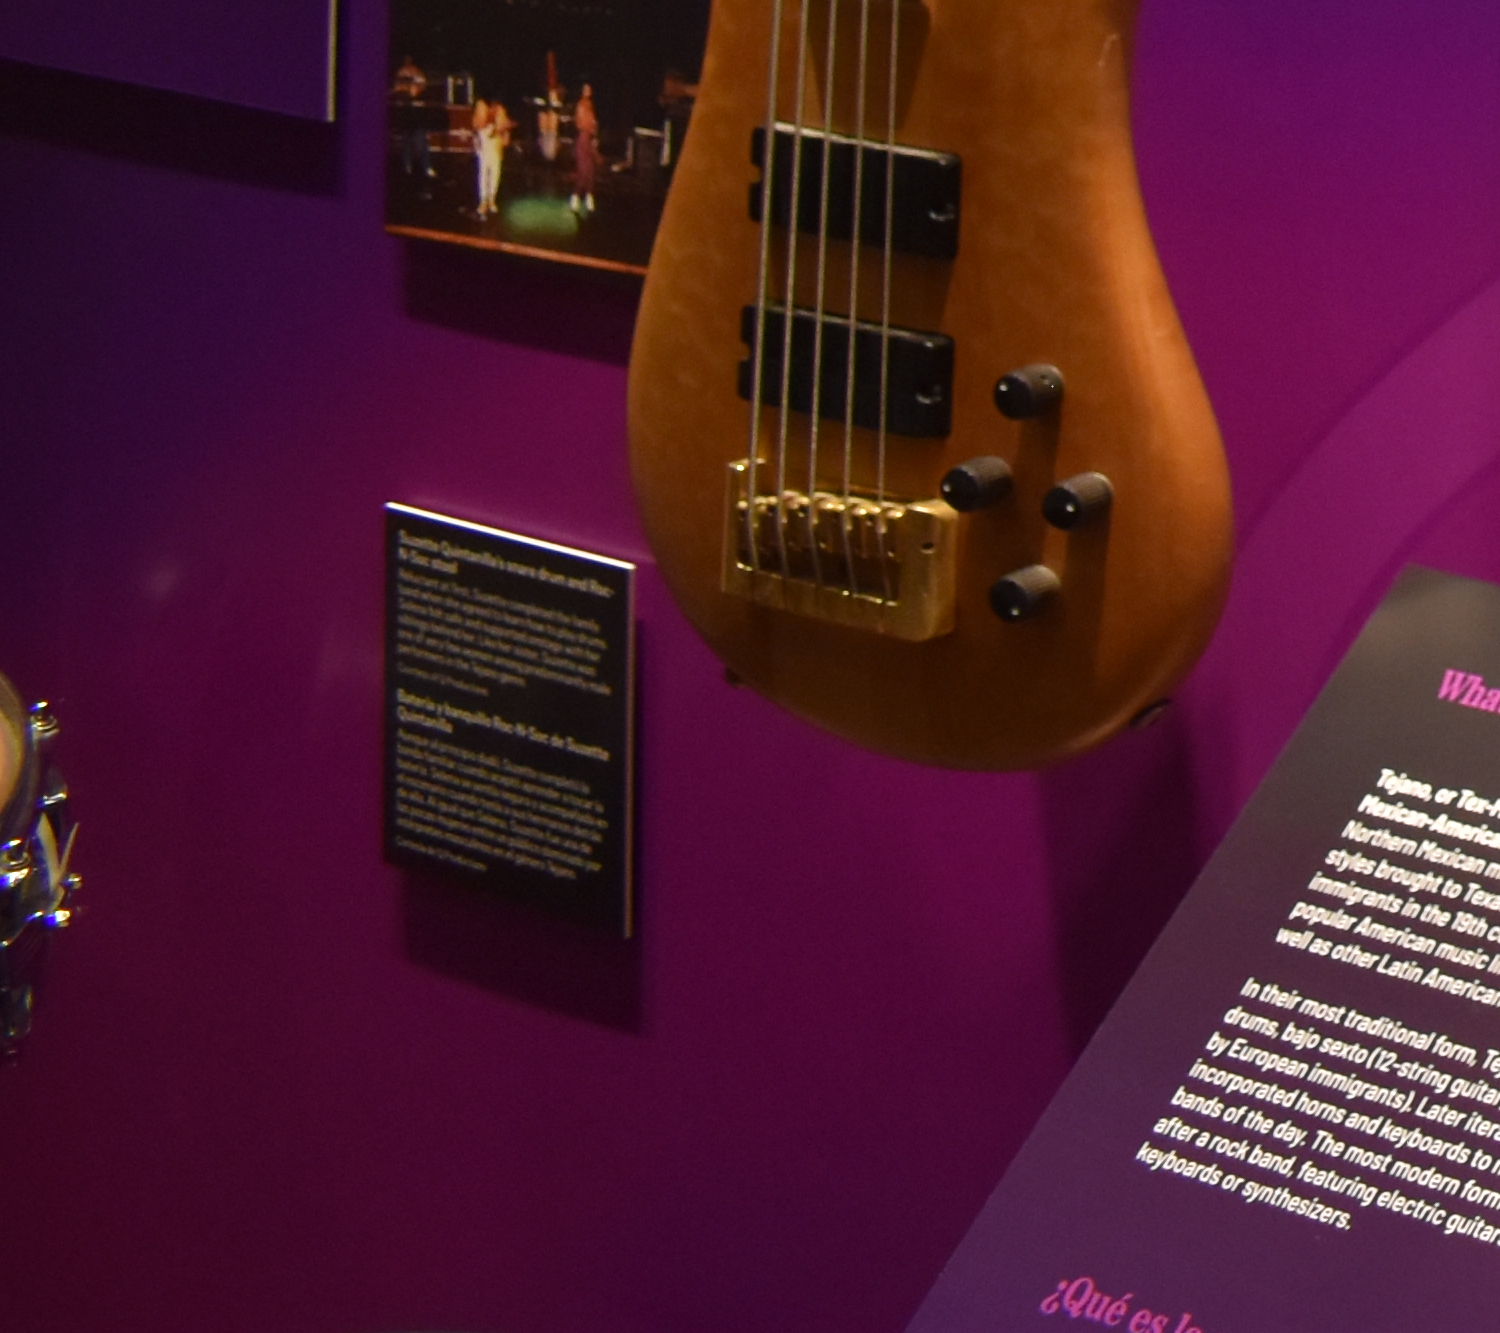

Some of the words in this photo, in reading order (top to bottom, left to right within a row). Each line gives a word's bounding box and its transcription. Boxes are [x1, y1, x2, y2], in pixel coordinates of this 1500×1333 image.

[1377, 768, 1431, 801] Tejano,
[1434, 788, 1458, 804] or
[1342, 820, 1417, 854] Northern
[1416, 839, 1486, 873] Mexican
[1325, 849, 1376, 874] styles
[1374, 859, 1443, 892] brought
[1441, 879, 1462, 898] to
[1039, 1277, 1134, 1325] ¿Qué
[1127, 1308, 1169, 1333] es
